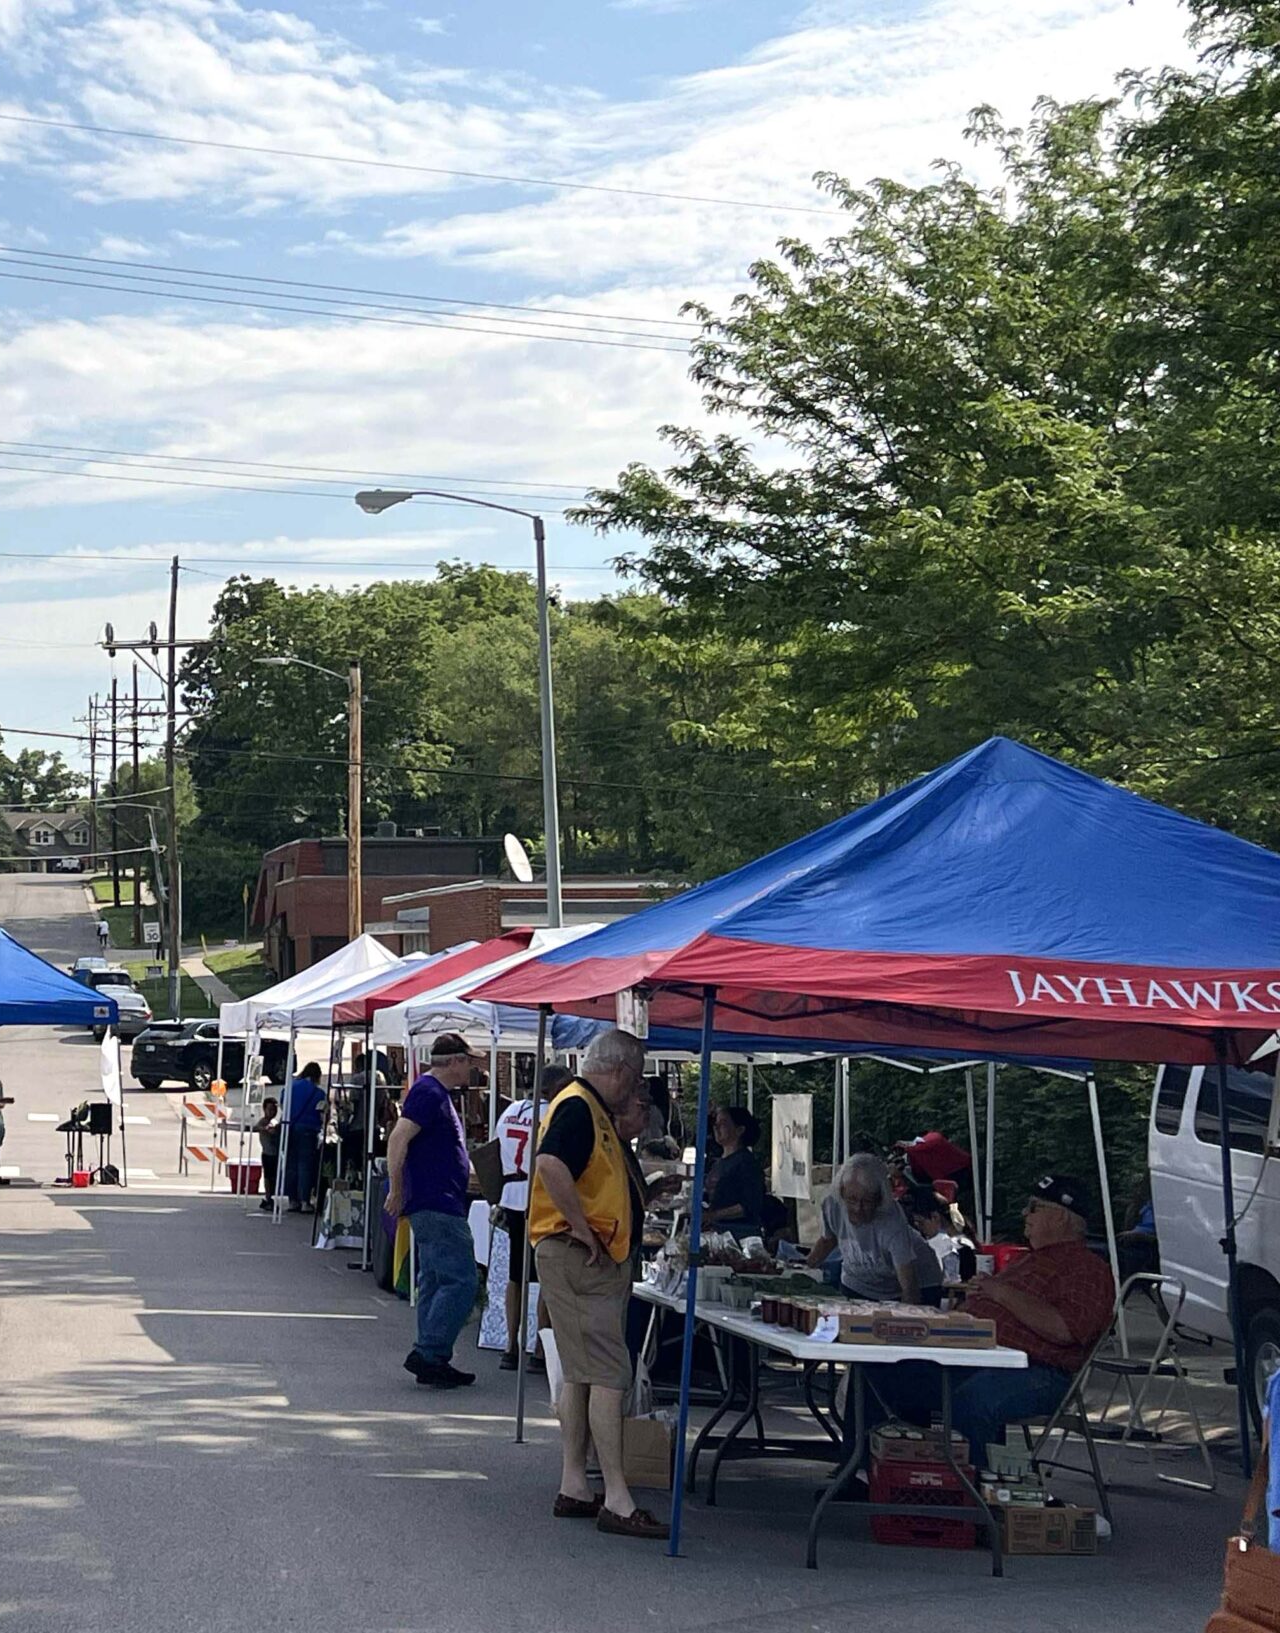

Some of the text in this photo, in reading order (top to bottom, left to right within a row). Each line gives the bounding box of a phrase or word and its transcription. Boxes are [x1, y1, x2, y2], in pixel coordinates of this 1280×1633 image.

[146, 932, 158, 941] 30
[1005, 969, 1280, 1013] JAYHAWKS
[506, 1128, 529, 1173] 7
